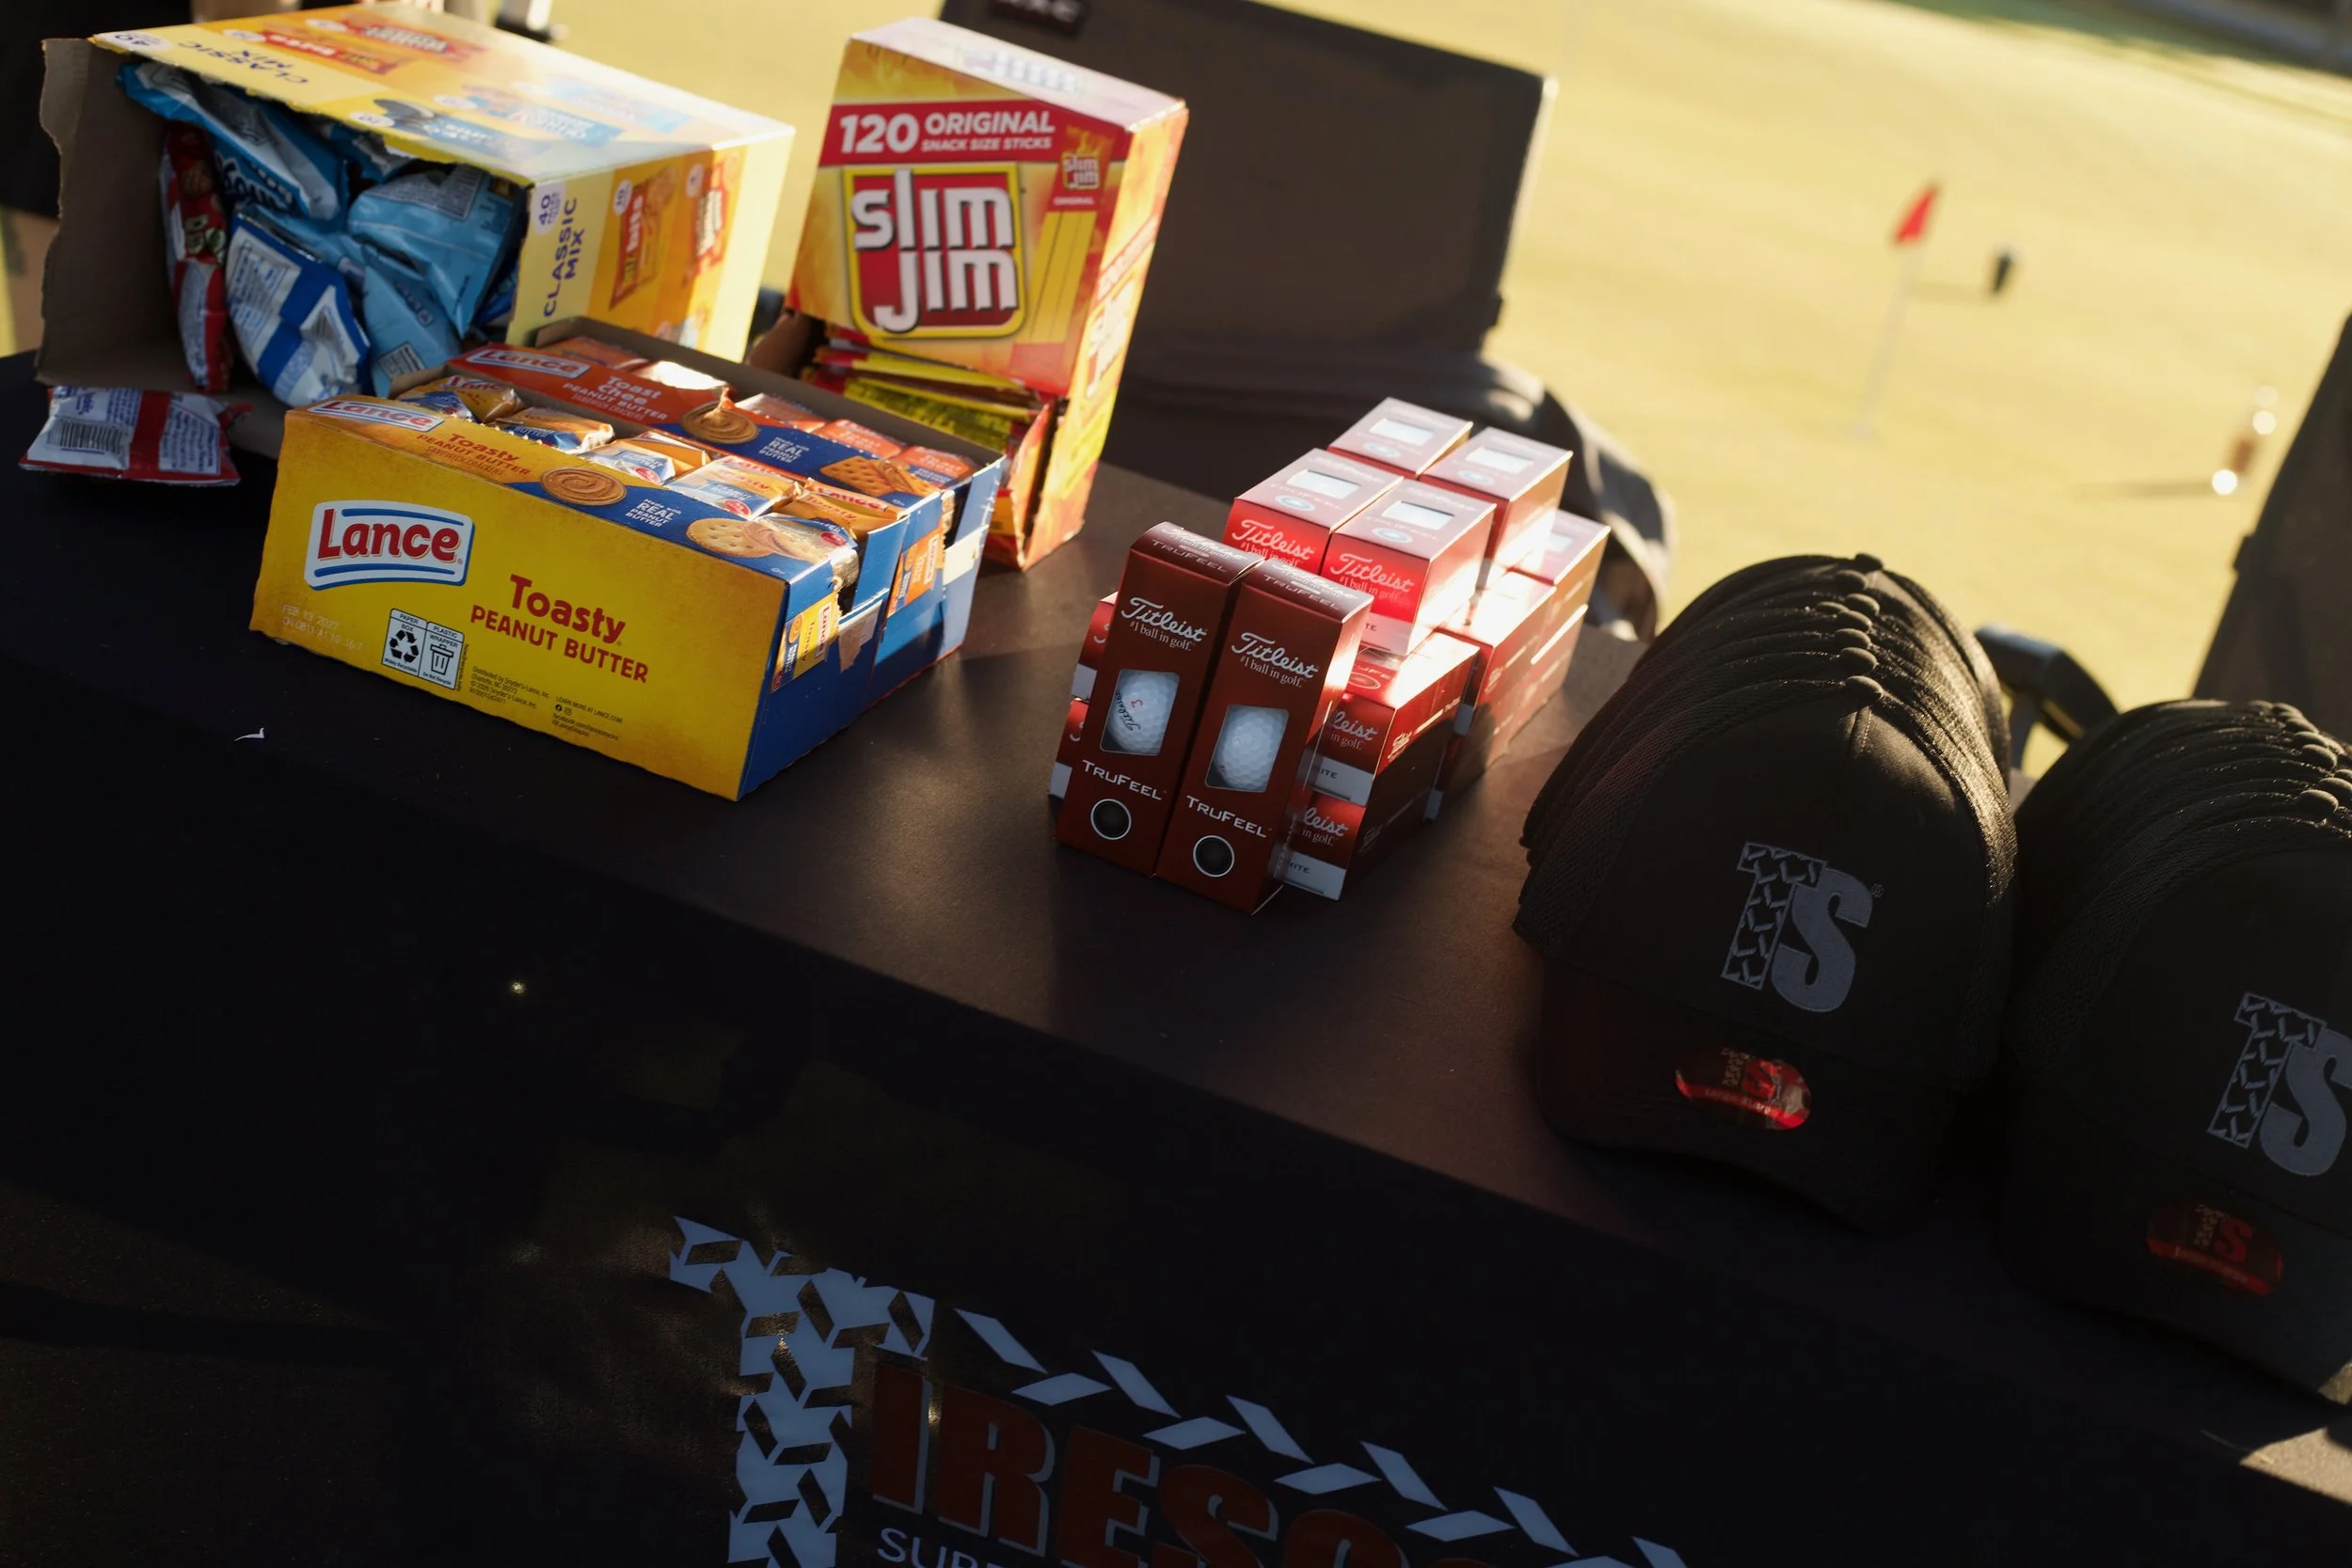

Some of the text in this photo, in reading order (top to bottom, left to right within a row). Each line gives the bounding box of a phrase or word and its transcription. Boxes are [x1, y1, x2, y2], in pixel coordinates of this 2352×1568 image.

[178, 40, 309, 84] CLASSIC
[840, 113, 920, 153] 120
[925, 111, 1056, 135] ORIGINAL
[921, 136, 1052, 151] SNACK SIZE STICKS
[539, 195, 551, 225] 40
[544, 198, 578, 316] CLASSIC
[564, 229, 585, 279] MIX
[481, 350, 580, 373] Lance
[597, 384, 648, 405] Chee
[609, 375, 662, 399] Toast
[322, 400, 434, 427] Lance
[563, 382, 669, 420] PEANUT BUTTER
[417, 434, 532, 476] PEANUT BUTTER
[449, 433, 520, 462] Toasty
[768, 440, 803, 457] REAL
[625, 512, 663, 529] BUTTER
[629, 508, 669, 526] PEANUT
[637, 502, 675, 521] REAL
[316, 507, 460, 562] Lance
[1231, 519, 1316, 562] Titleist
[1151, 539, 1227, 573] TRUFEEL
[1330, 552, 1415, 594] Titleist
[1340, 576, 1349, 588] #1
[1348, 578, 1366, 593] ball
[1368, 583, 1378, 594] in
[1263, 575, 1342, 610] TRUFEEL
[399, 613, 419, 625] PAPER
[510, 573, 627, 645] Toasty
[1120, 596, 1207, 643] Titleist
[401, 624, 414, 632] BOX
[433, 625, 458, 639] PLASTIC
[1130, 620, 1138, 632] #1
[1139, 623, 1158, 641] ball
[1159, 631, 1169, 644] in
[429, 634, 459, 648] WRAPPER
[470, 605, 649, 685] PEANUT BUTTER
[1231, 632, 1319, 678] Titleist
[1240, 656, 1248, 667] #1
[1249, 658, 1269, 674] ball
[1269, 667, 1280, 679] in
[1330, 731, 1340, 742] in
[1333, 710, 1378, 741] leist
[1320, 768, 1338, 780] ITE
[1302, 829, 1311, 839] in
[1303, 806, 1349, 837] leist
[1290, 861, 1311, 874] ITE
